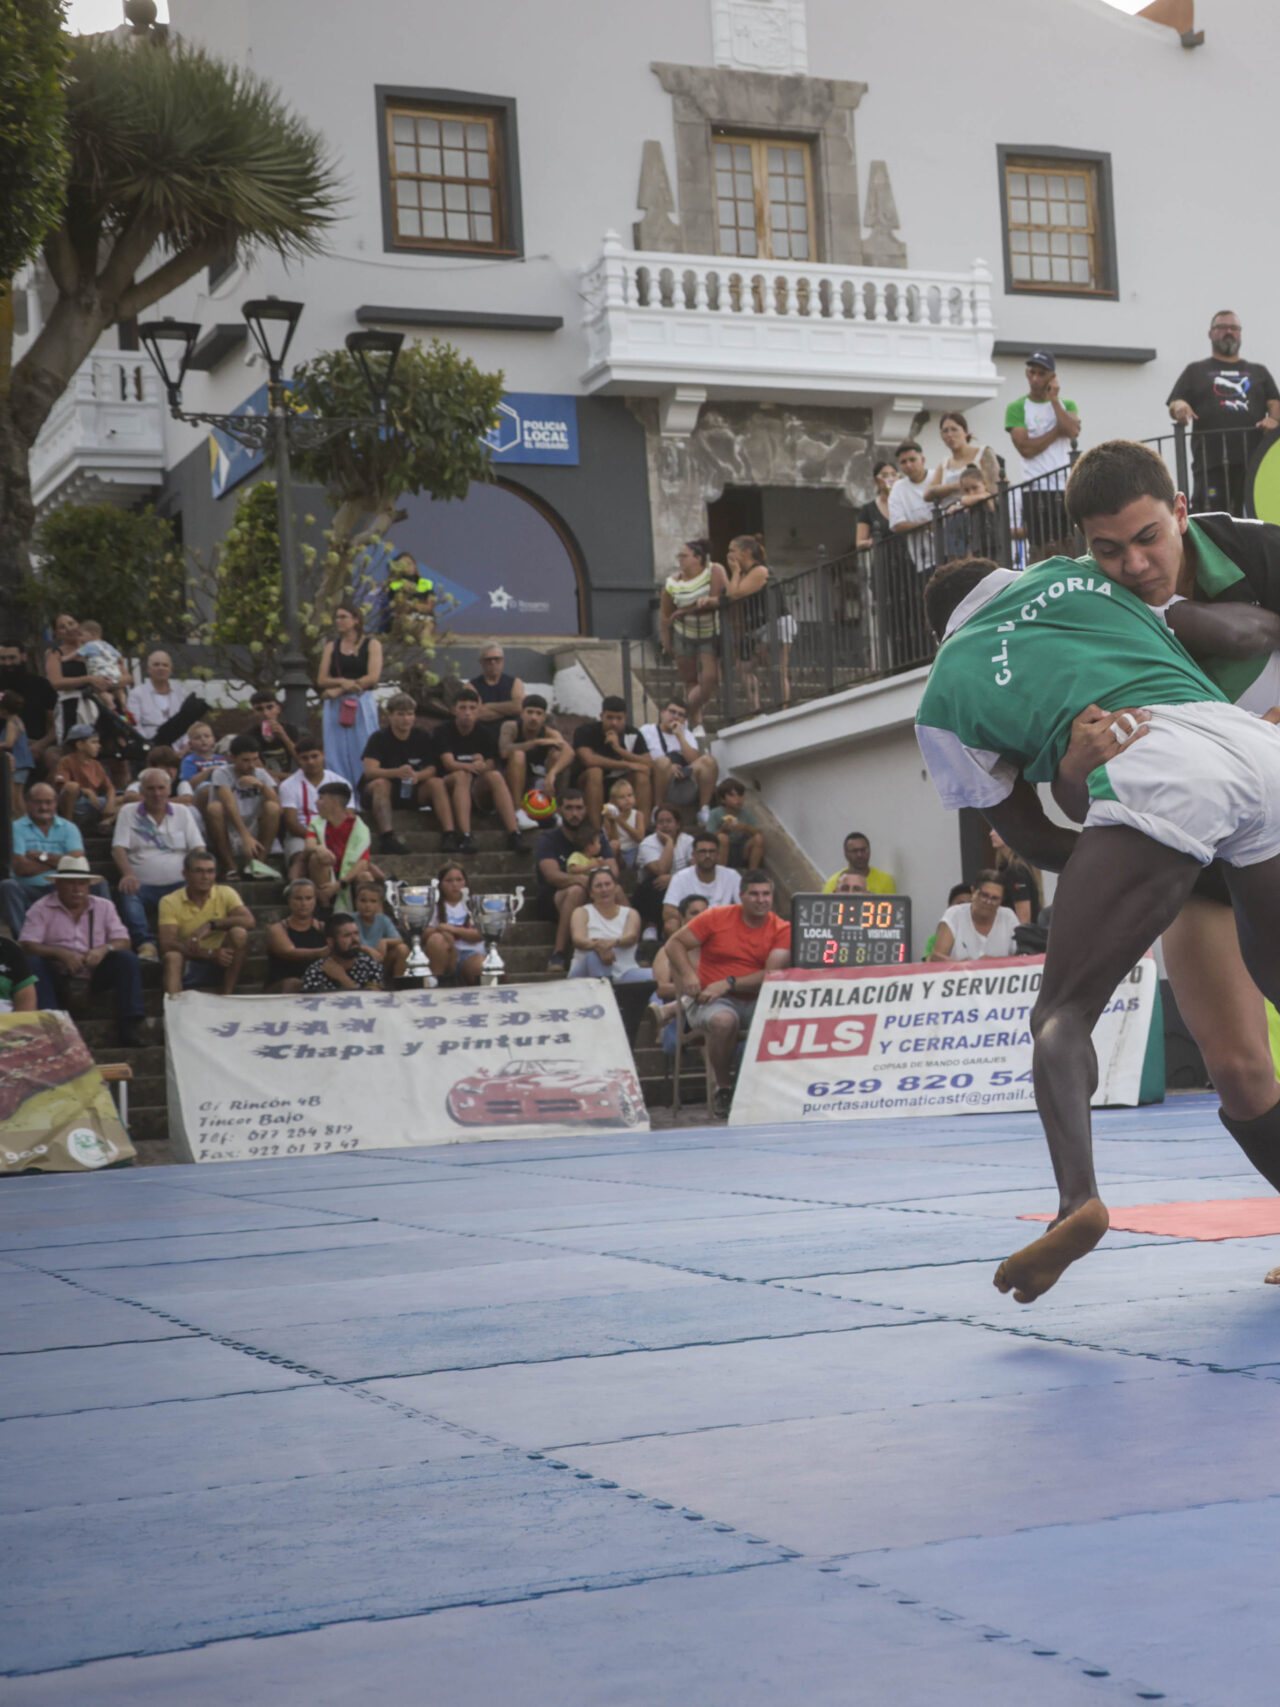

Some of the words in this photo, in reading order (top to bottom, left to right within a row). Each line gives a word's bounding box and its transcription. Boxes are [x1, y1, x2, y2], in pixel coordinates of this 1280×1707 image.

[523, 430, 568, 443] LOCAL
[997, 577, 1112, 633] VCTORIA
[991, 639, 1012, 686] C.L.
[837, 902, 892, 928] 1:30
[804, 928, 833, 939] LOCAL
[867, 929, 901, 939] VISITANTE
[823, 940, 838, 964] 2
[898, 943, 905, 963] 1
[296, 990, 519, 1012] TALLER
[769, 981, 913, 1009] INSTALACIÓN
[922, 980, 935, 999] Y
[941, 973, 1043, 998] SERVICIO
[207, 1018, 377, 1038] JUAN
[412, 1005, 606, 1030] PEDRO
[883, 1008, 979, 1029] PUERTAS
[251, 1043, 385, 1060] Chapa
[401, 1040, 424, 1056] y
[437, 1032, 572, 1055] pintura
[767, 1020, 866, 1056] JLS
[879, 1040, 893, 1055] Y
[899, 1029, 1032, 1053] CERRAJERÍA
[873, 1061, 908, 1072] COPIAS
[910, 1060, 923, 1069] DE
[926, 1058, 960, 1068] MANDO
[962, 1056, 1007, 1066] GARAJES
[807, 1078, 882, 1097] 629
[897, 1073, 974, 1092] 820
[989, 1069, 1034, 1087] 54
[230, 1098, 292, 1110] Rincón
[802, 1087, 1037, 1115] puertasautomaticastf@gmail.c
[258, 1113, 304, 1126] Bajo
[248, 1145, 280, 1157] 922
